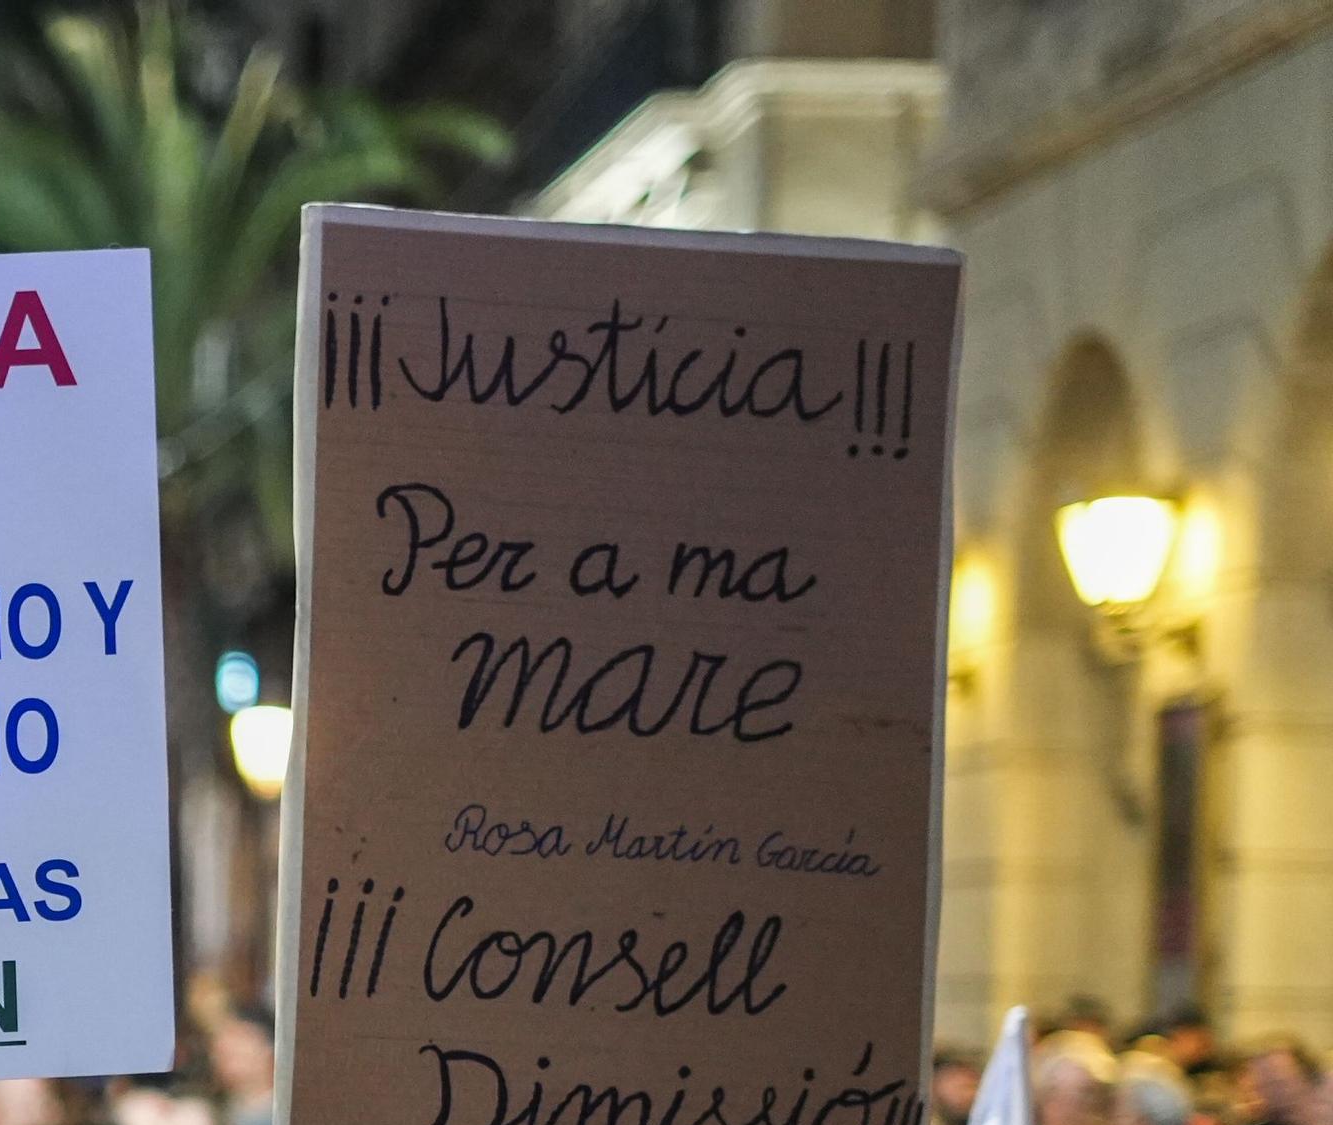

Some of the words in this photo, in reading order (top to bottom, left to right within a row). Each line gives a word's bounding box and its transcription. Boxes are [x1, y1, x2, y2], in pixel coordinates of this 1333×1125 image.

[377, 483, 536, 596] Per
[570, 543, 639, 598] a
[668, 543, 817, 602] ma
[90, 580, 134, 656] Y
[445, 805, 572, 859] Rosa
